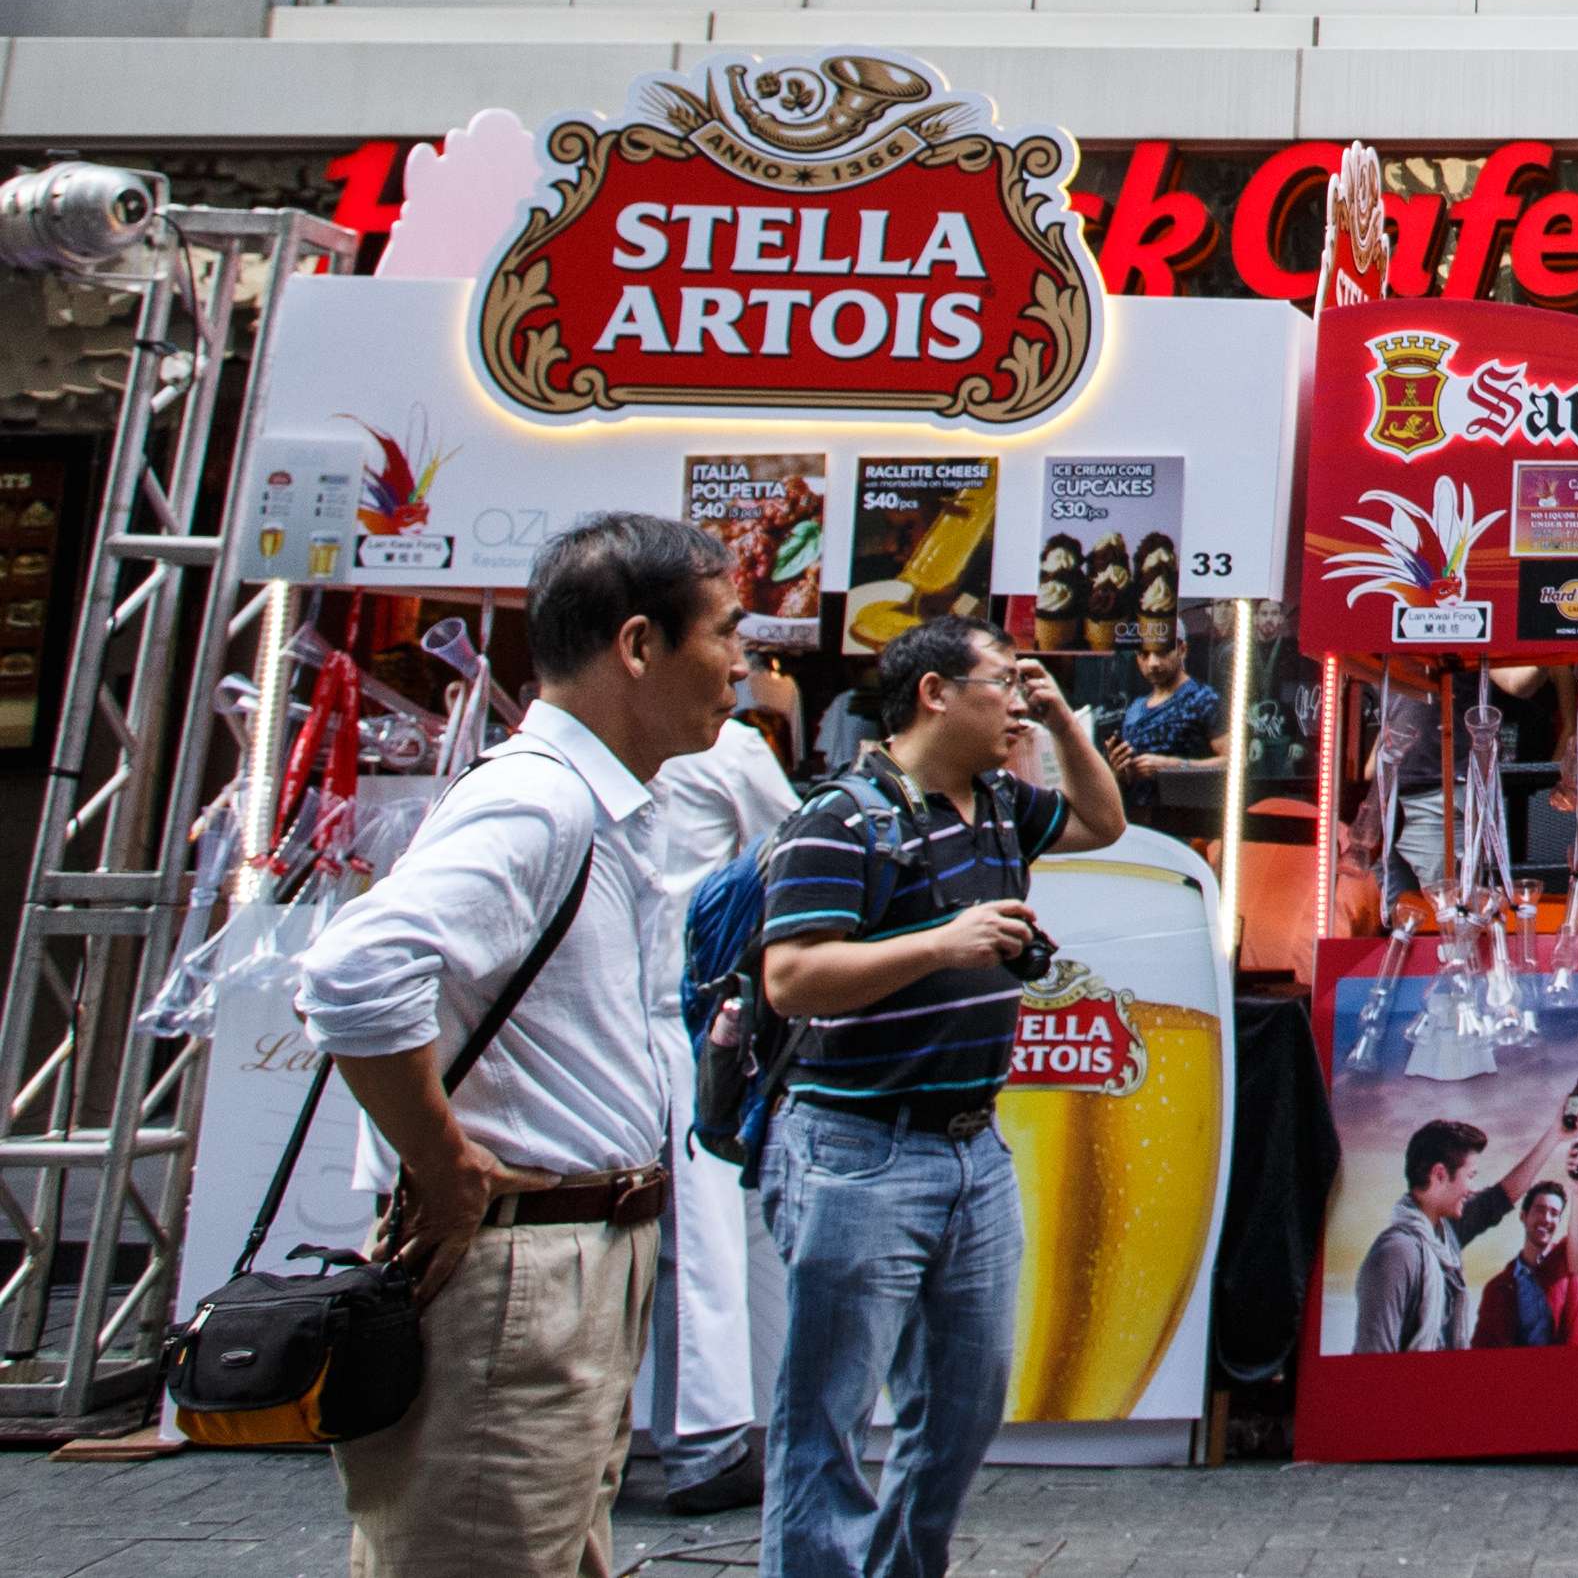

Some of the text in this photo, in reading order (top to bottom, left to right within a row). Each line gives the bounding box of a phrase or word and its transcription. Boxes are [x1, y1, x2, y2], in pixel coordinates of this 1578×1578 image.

[705, 134, 905, 181] ANNO 1366
[612, 202, 989, 279] STELLA
[592, 285, 983, 362] ARTOIS
[692, 464, 749, 481] ITALIA
[865, 464, 989, 478] RACLETTE CHEESE
[1053, 464, 1153, 476] ICE CREAM CONE
[691, 482, 787, 500] POLPETTA
[1053, 480, 1153, 496] CUPCAKES
[690, 502, 726, 520] $40
[1531, 512, 1543, 520] NO
[1544, 512, 1576, 520] LIQUOR
[1190, 552, 1233, 576] 33
[1540, 586, 1578, 605] Hard
[1408, 612, 1477, 623] Lan Kwai Fong
[1020, 1014, 1113, 1042] ELLA
[1011, 1045, 1114, 1073] RTOIS
